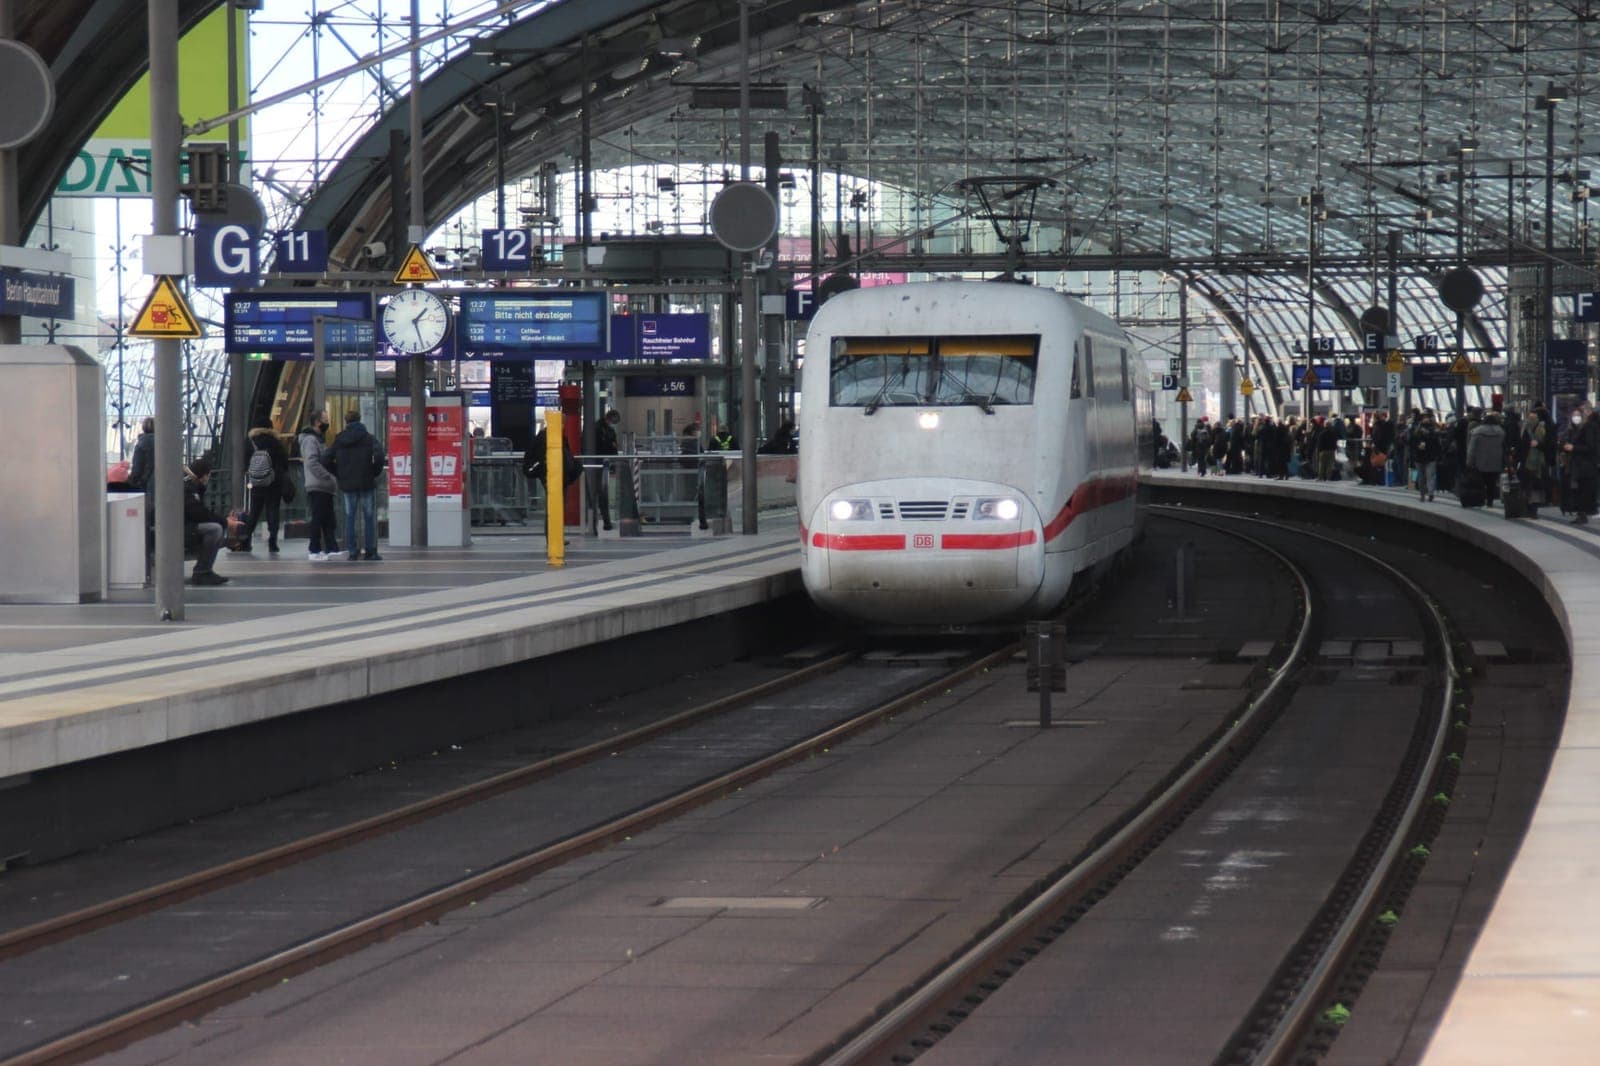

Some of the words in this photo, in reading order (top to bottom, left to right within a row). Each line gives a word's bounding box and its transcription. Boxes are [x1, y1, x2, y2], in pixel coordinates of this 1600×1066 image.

[213, 225, 250, 274] G
[282, 231, 308, 260] 11
[492, 230, 526, 259] 12
[6, 279, 22, 301] Berlin
[798, 291, 812, 314] F
[1578, 293, 1593, 316] F
[495, 311, 512, 319] Bitte
[515, 311, 532, 319] nicht
[535, 311, 573, 320] einsteigen
[1315, 338, 1330, 350] 13
[1366, 334, 1376, 349] E
[1421, 336, 1436, 349] 14
[1171, 360, 1179, 369] H
[1163, 375, 1173, 388] D
[1336, 368, 1353, 382] 13
[1391, 375, 1397, 384] 5
[670, 381, 685, 391] 5/6
[1391, 385, 1397, 394] 4
[916, 536, 932, 546] DB
